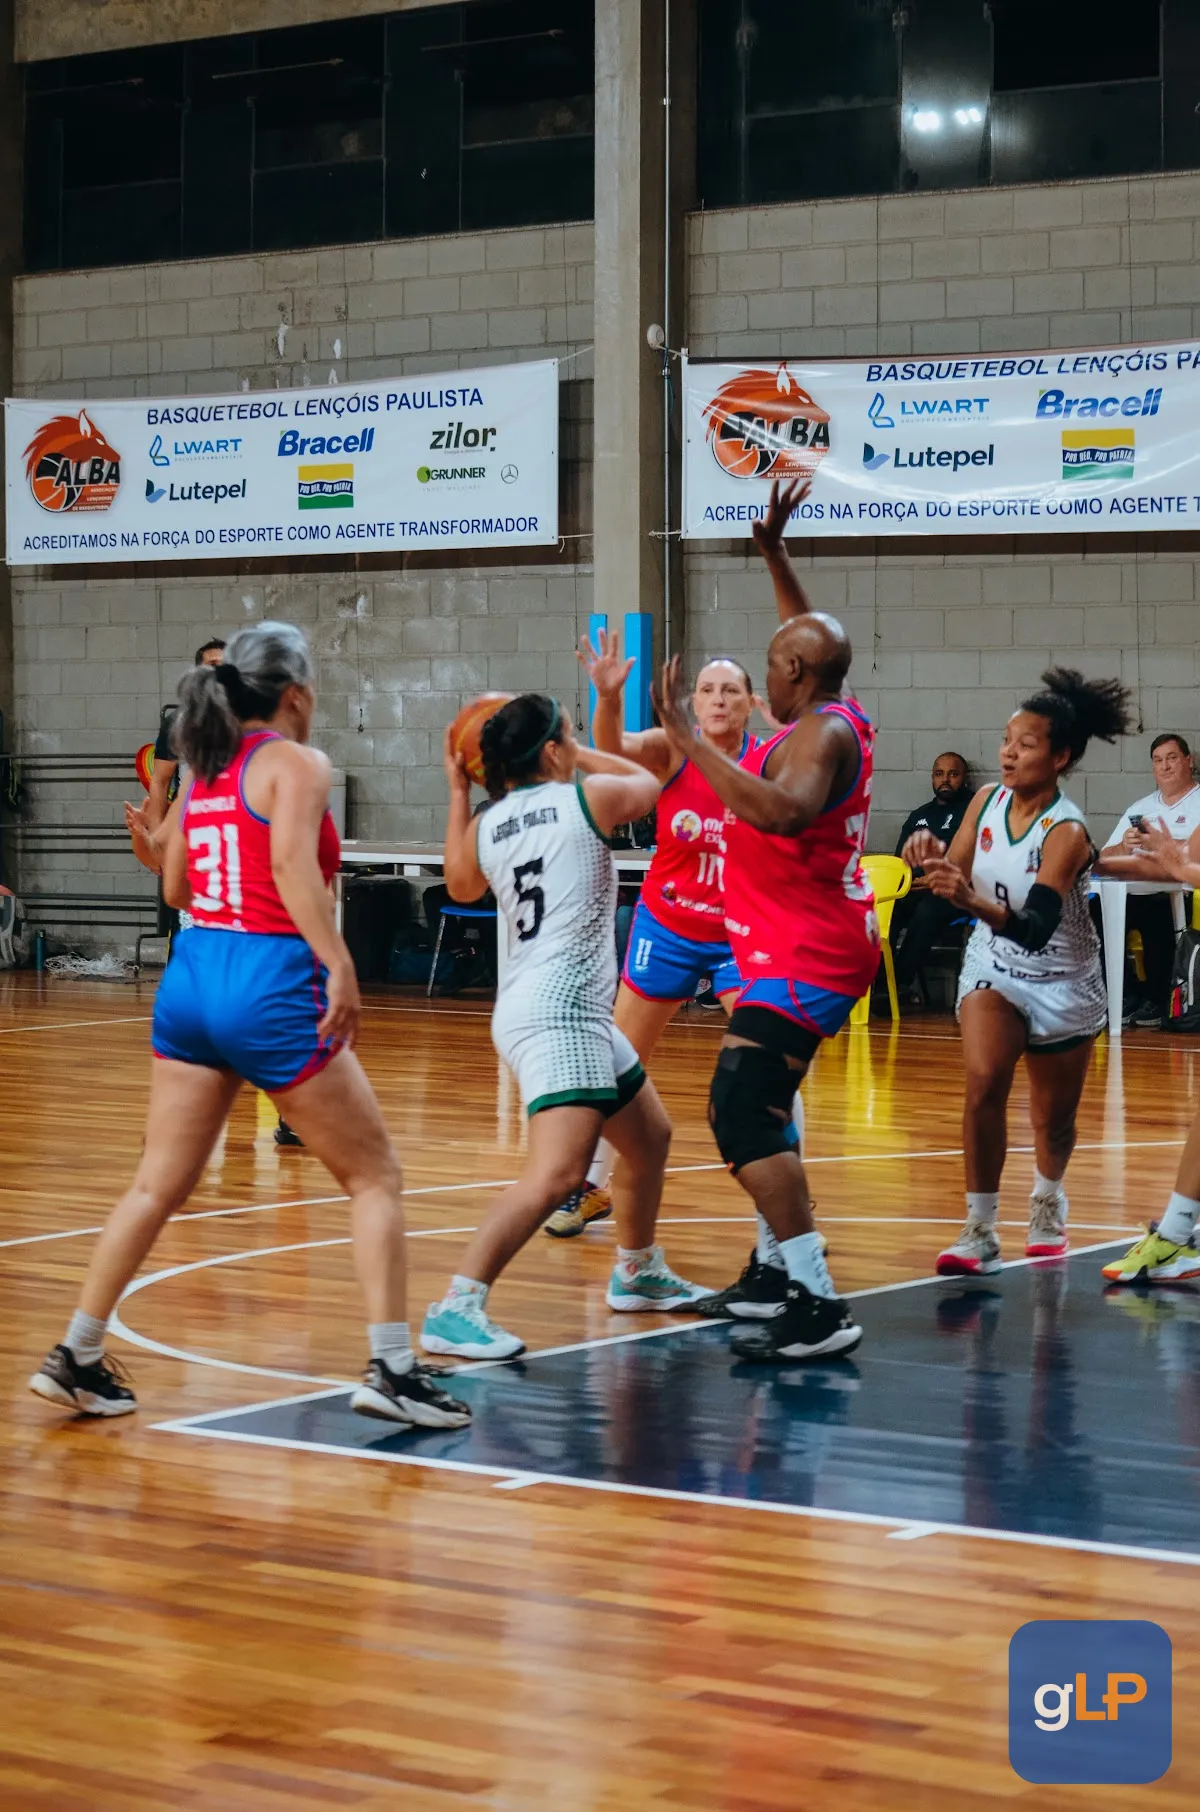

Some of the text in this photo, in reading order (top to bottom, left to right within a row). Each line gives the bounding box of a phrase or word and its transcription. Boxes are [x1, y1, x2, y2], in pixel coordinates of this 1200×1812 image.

[866, 359, 1049, 382] BASQUETEBOL
[1057, 350, 1167, 378] LENÇÓIS
[147, 388, 484, 425] BASQUETEBOL LENÇÓIS PAULISTA
[901, 398, 990, 415] LWART
[1035, 387, 1163, 420] Bracell
[174, 438, 243, 455] LWART
[277, 427, 376, 457] Bracell
[743, 417, 830, 450] ALBA
[54, 457, 121, 487] ALBA
[894, 444, 994, 472] Lutepel
[430, 467, 486, 480] GRUNNER
[169, 478, 247, 504] Lutepel
[703, 503, 825, 521] ACREDIMOS
[830, 502, 853, 519] NA
[859, 502, 918, 522] FORÇA
[926, 501, 951, 517] DO
[957, 499, 1041, 517] ESPORTE
[1046, 498, 1102, 515] COMO
[1109, 496, 1188, 514] AGENTE
[23, 516, 539, 550] ACREDITAMOS NA FORÇA DO ESPORTE COMO AGENTE TRANSFORMADOR
[188, 823, 243, 914] 31
[513, 857, 545, 942] 5
[635, 937, 653, 967] 11
